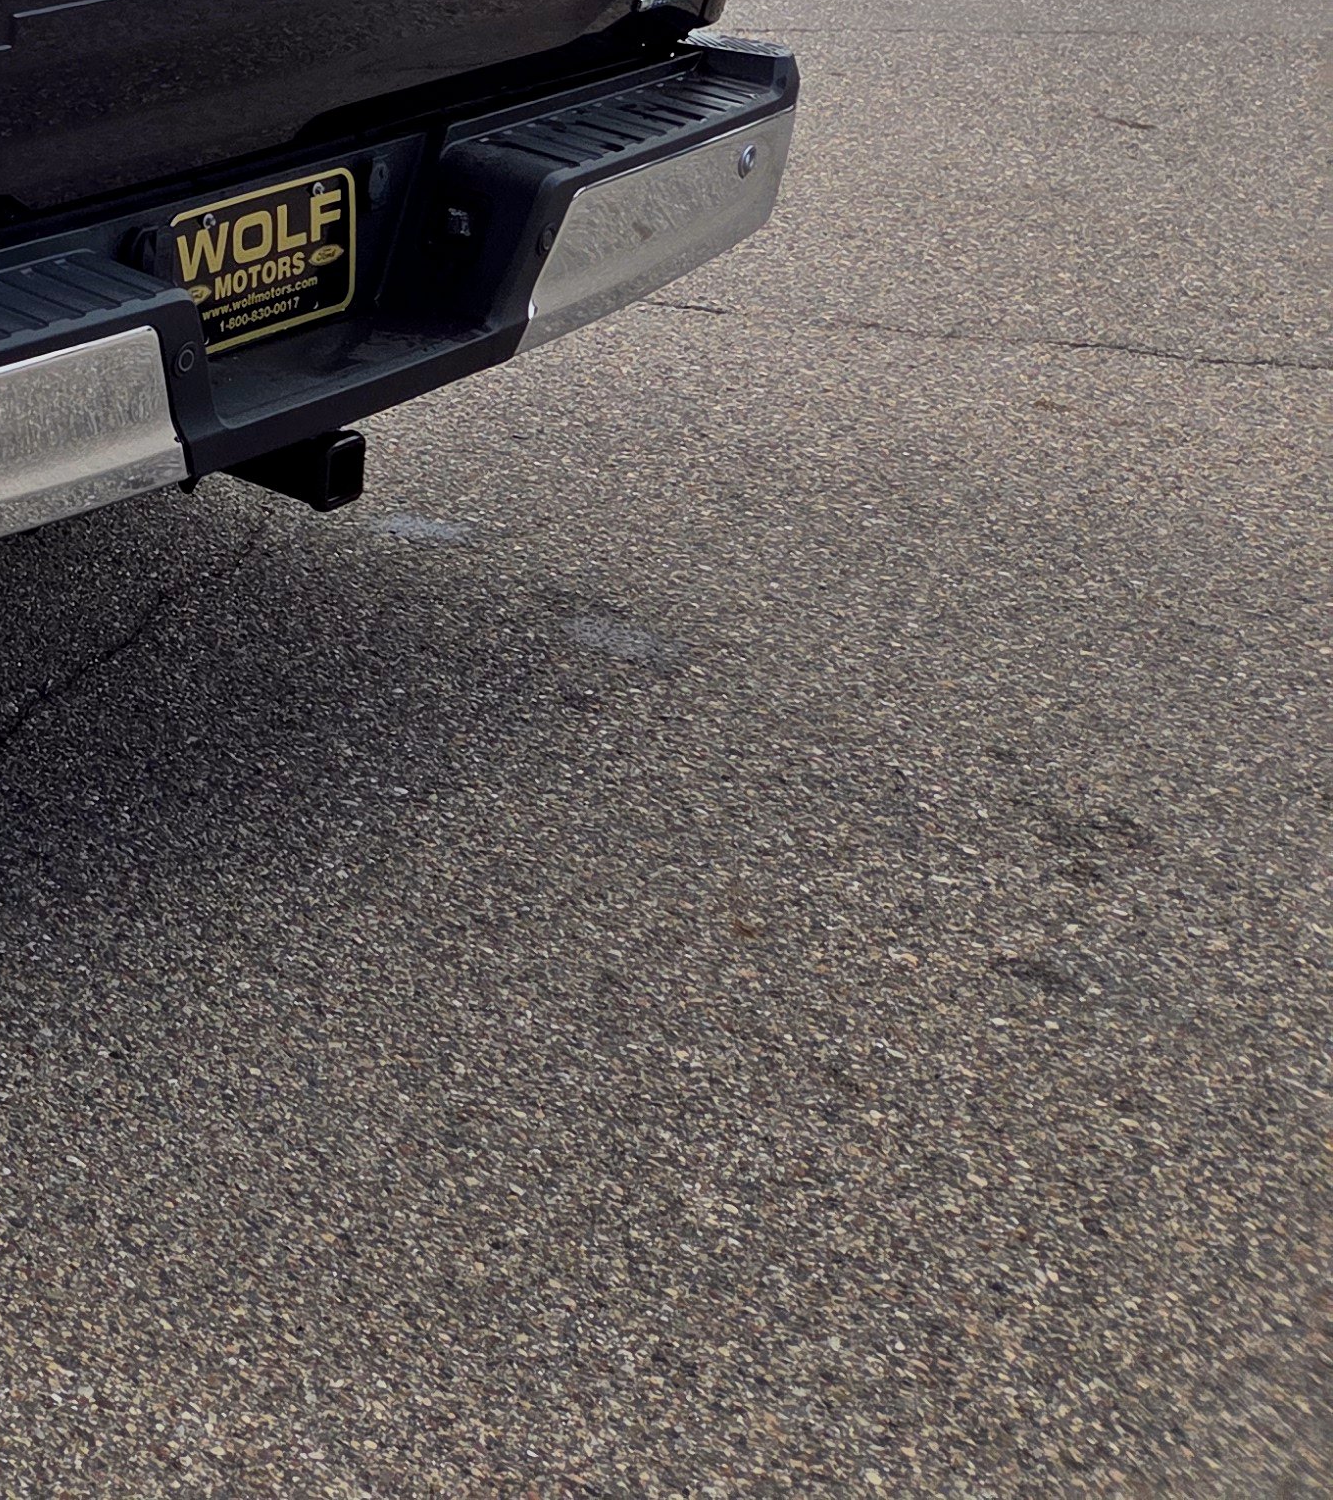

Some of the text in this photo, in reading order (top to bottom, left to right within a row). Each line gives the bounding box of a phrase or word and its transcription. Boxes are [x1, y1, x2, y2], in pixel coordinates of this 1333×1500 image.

[176, 189, 341, 282] WOLF
[202, 276, 318, 321] www.wolfmotors.com
[215, 252, 306, 300] MOTORS
[220, 296, 300, 332] 1-800-830-0017
